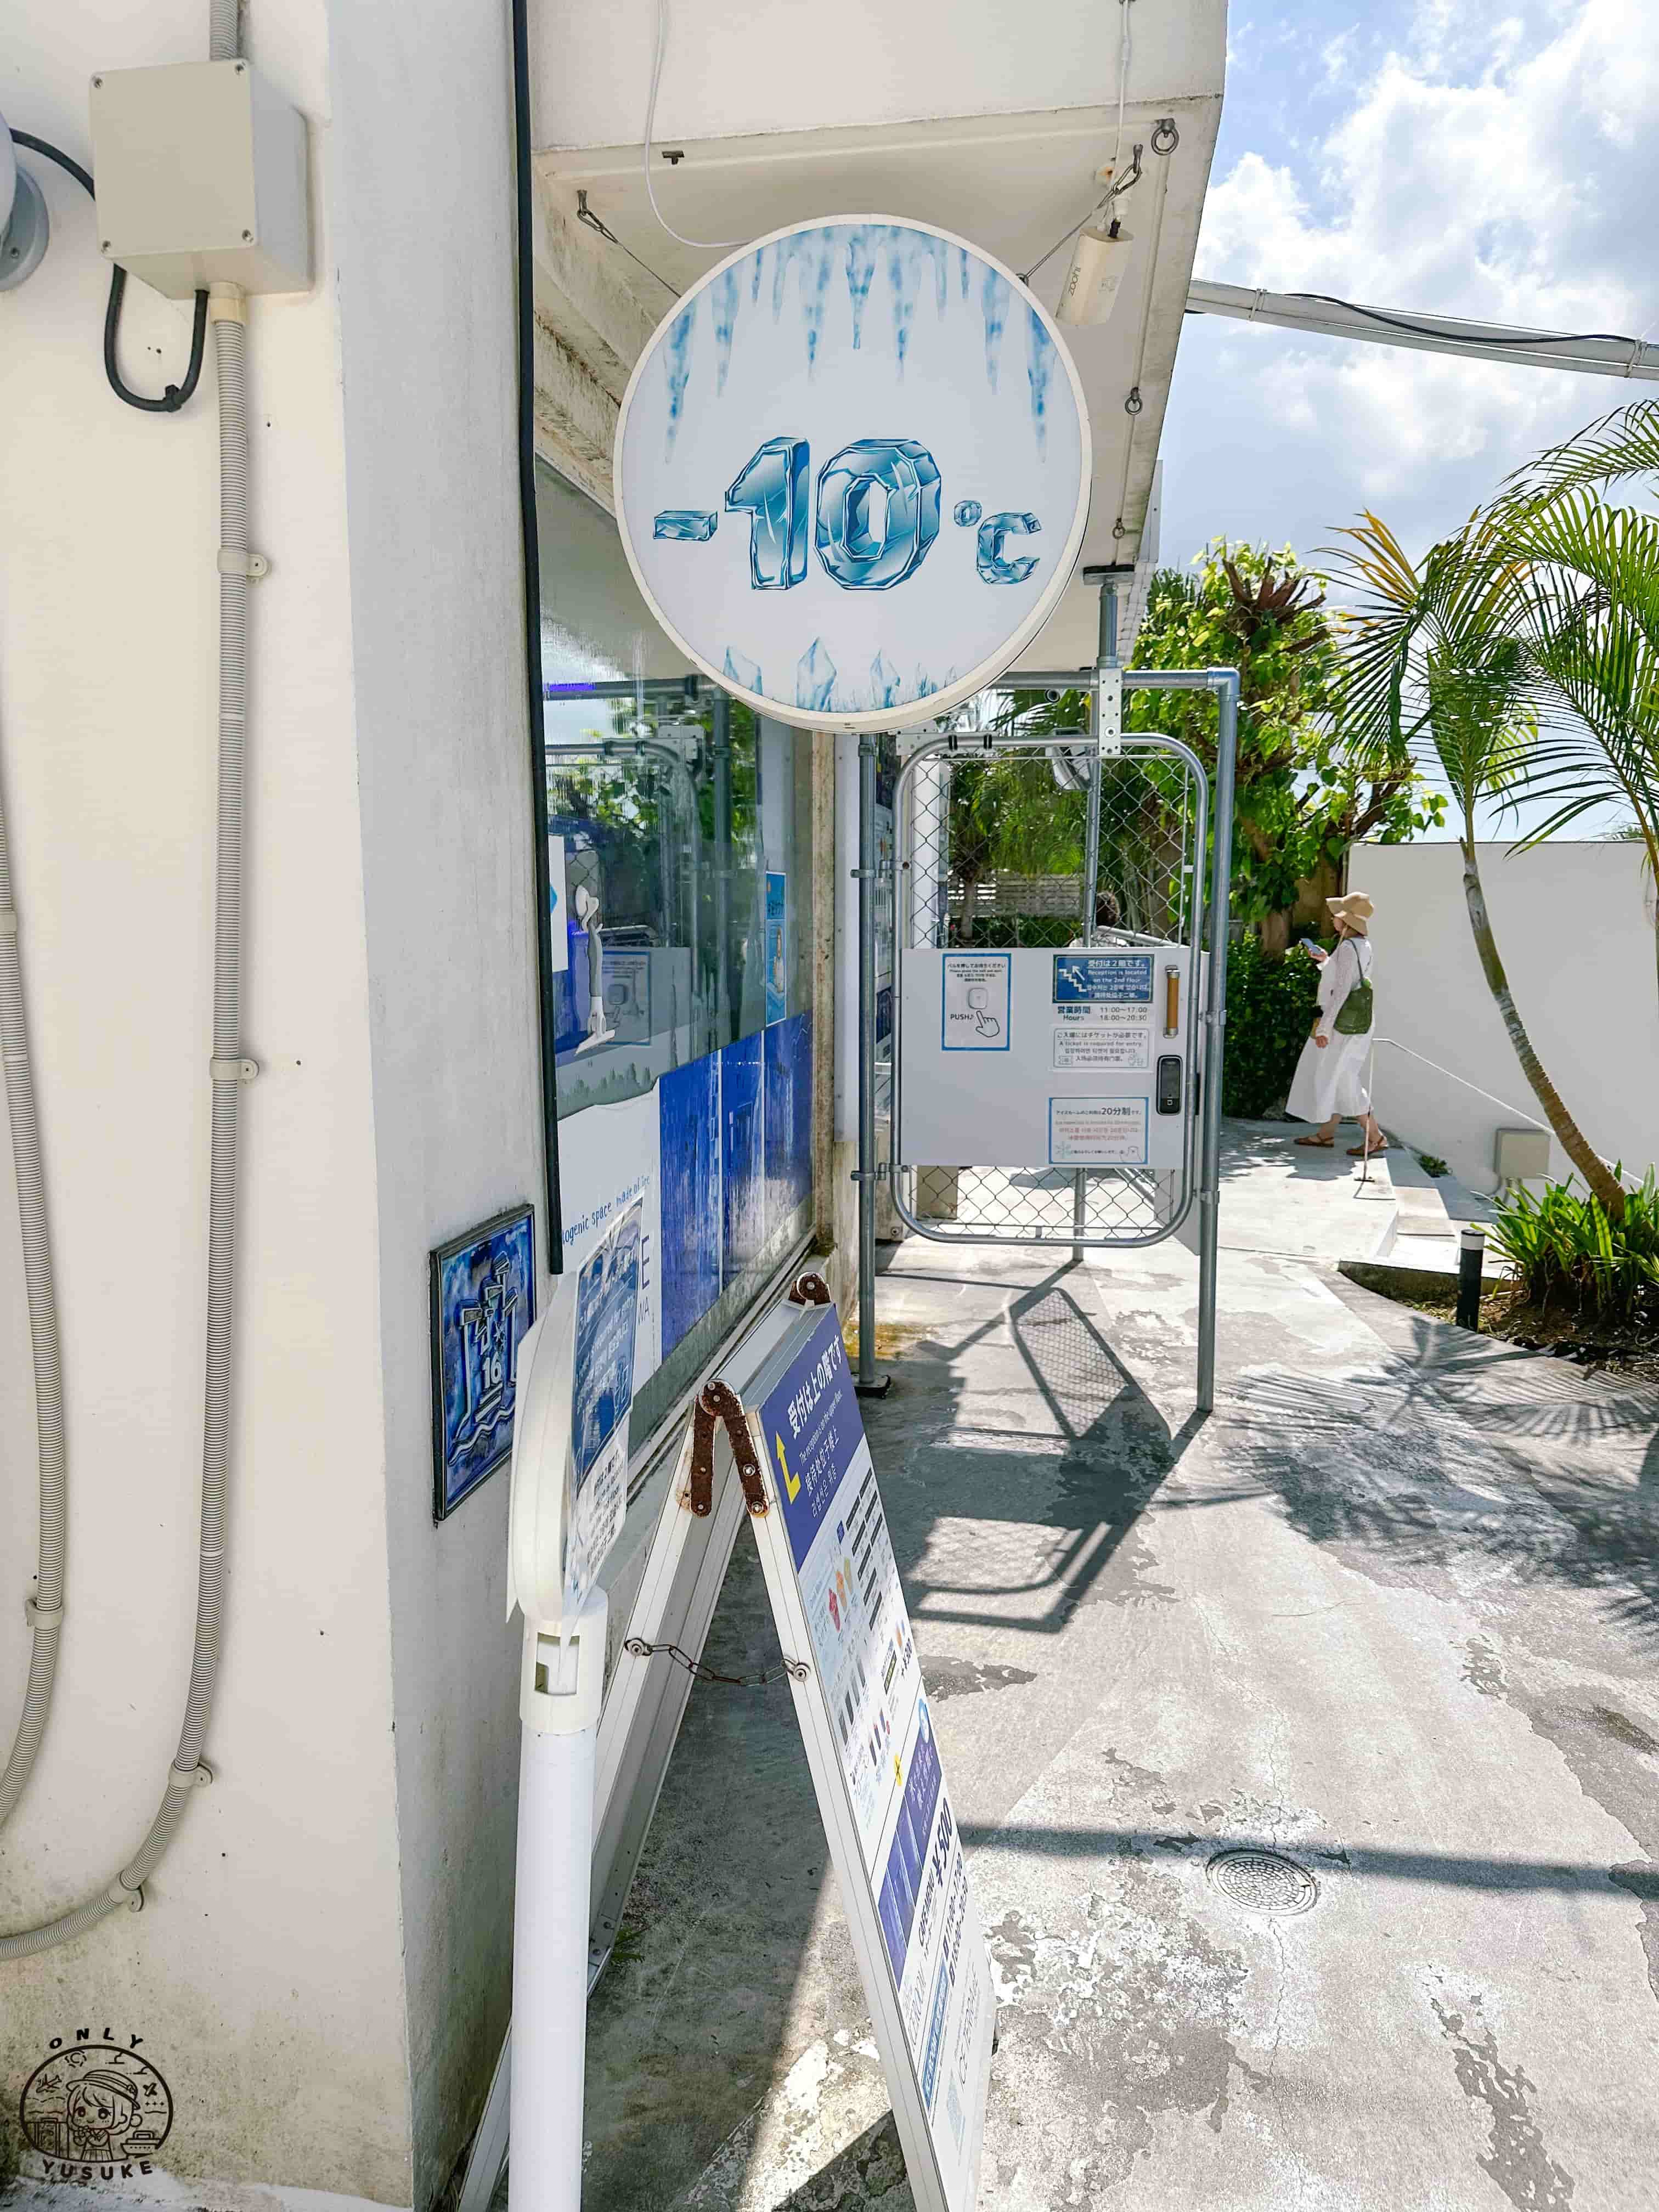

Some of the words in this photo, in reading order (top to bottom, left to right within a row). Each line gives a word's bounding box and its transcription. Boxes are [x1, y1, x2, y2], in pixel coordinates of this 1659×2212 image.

[1058, 1006, 1091, 1014] 営業時間
[592, 1201, 612, 1229] space
[616, 1185, 633, 1207] made
[788, 1335, 842, 1439] 受付は上の階です
[805, 1429, 821, 1459] reception
[918, 1910, 929, 1946] CAFE
[924, 1868, 935, 1914] MENU
[933, 1797, 952, 1886] ¥500
